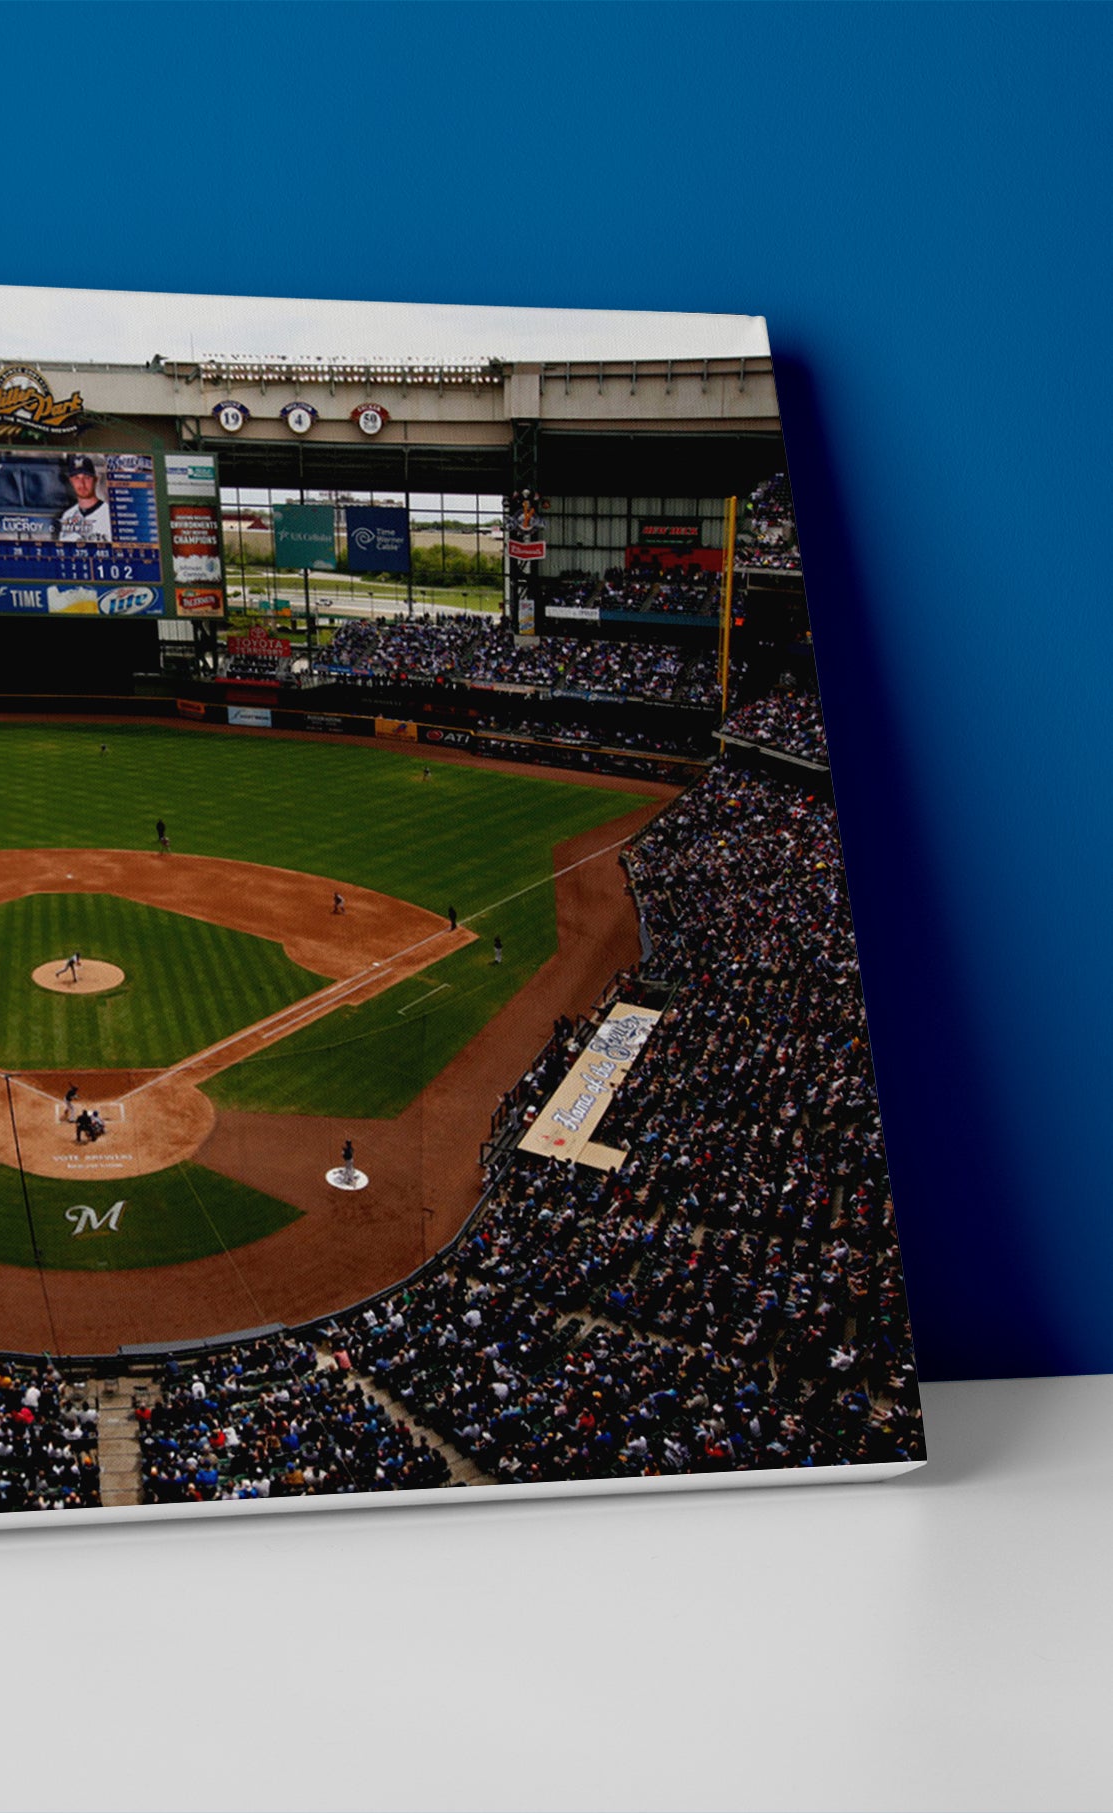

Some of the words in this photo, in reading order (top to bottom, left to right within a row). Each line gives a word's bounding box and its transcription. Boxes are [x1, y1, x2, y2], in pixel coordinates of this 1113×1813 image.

[23, 391, 83, 425] Park
[224, 412, 238, 425] 19
[294, 414, 302, 426] 4
[363, 413, 377, 423] 50
[3, 521, 43, 532] LUCROY
[170, 520, 218, 530] ENVIRONMENTS
[376, 528, 395, 536] Time
[173, 535, 217, 545] CHAMPIONS
[376, 535, 404, 543] Warner
[376, 543, 398, 551] Cable
[97, 565, 104, 578] 1
[110, 565, 120, 578] 0
[124, 565, 133, 579] 2
[10, 590, 43, 608] TIME
[109, 592, 149, 613] Lite
[237, 638, 283, 649] TOYOTA
[444, 732, 470, 743] ATI
[589, 1060, 617, 1081] the
[580, 1072, 609, 1095] of
[552, 1093, 596, 1132] Home
[65, 1200, 125, 1236] M
